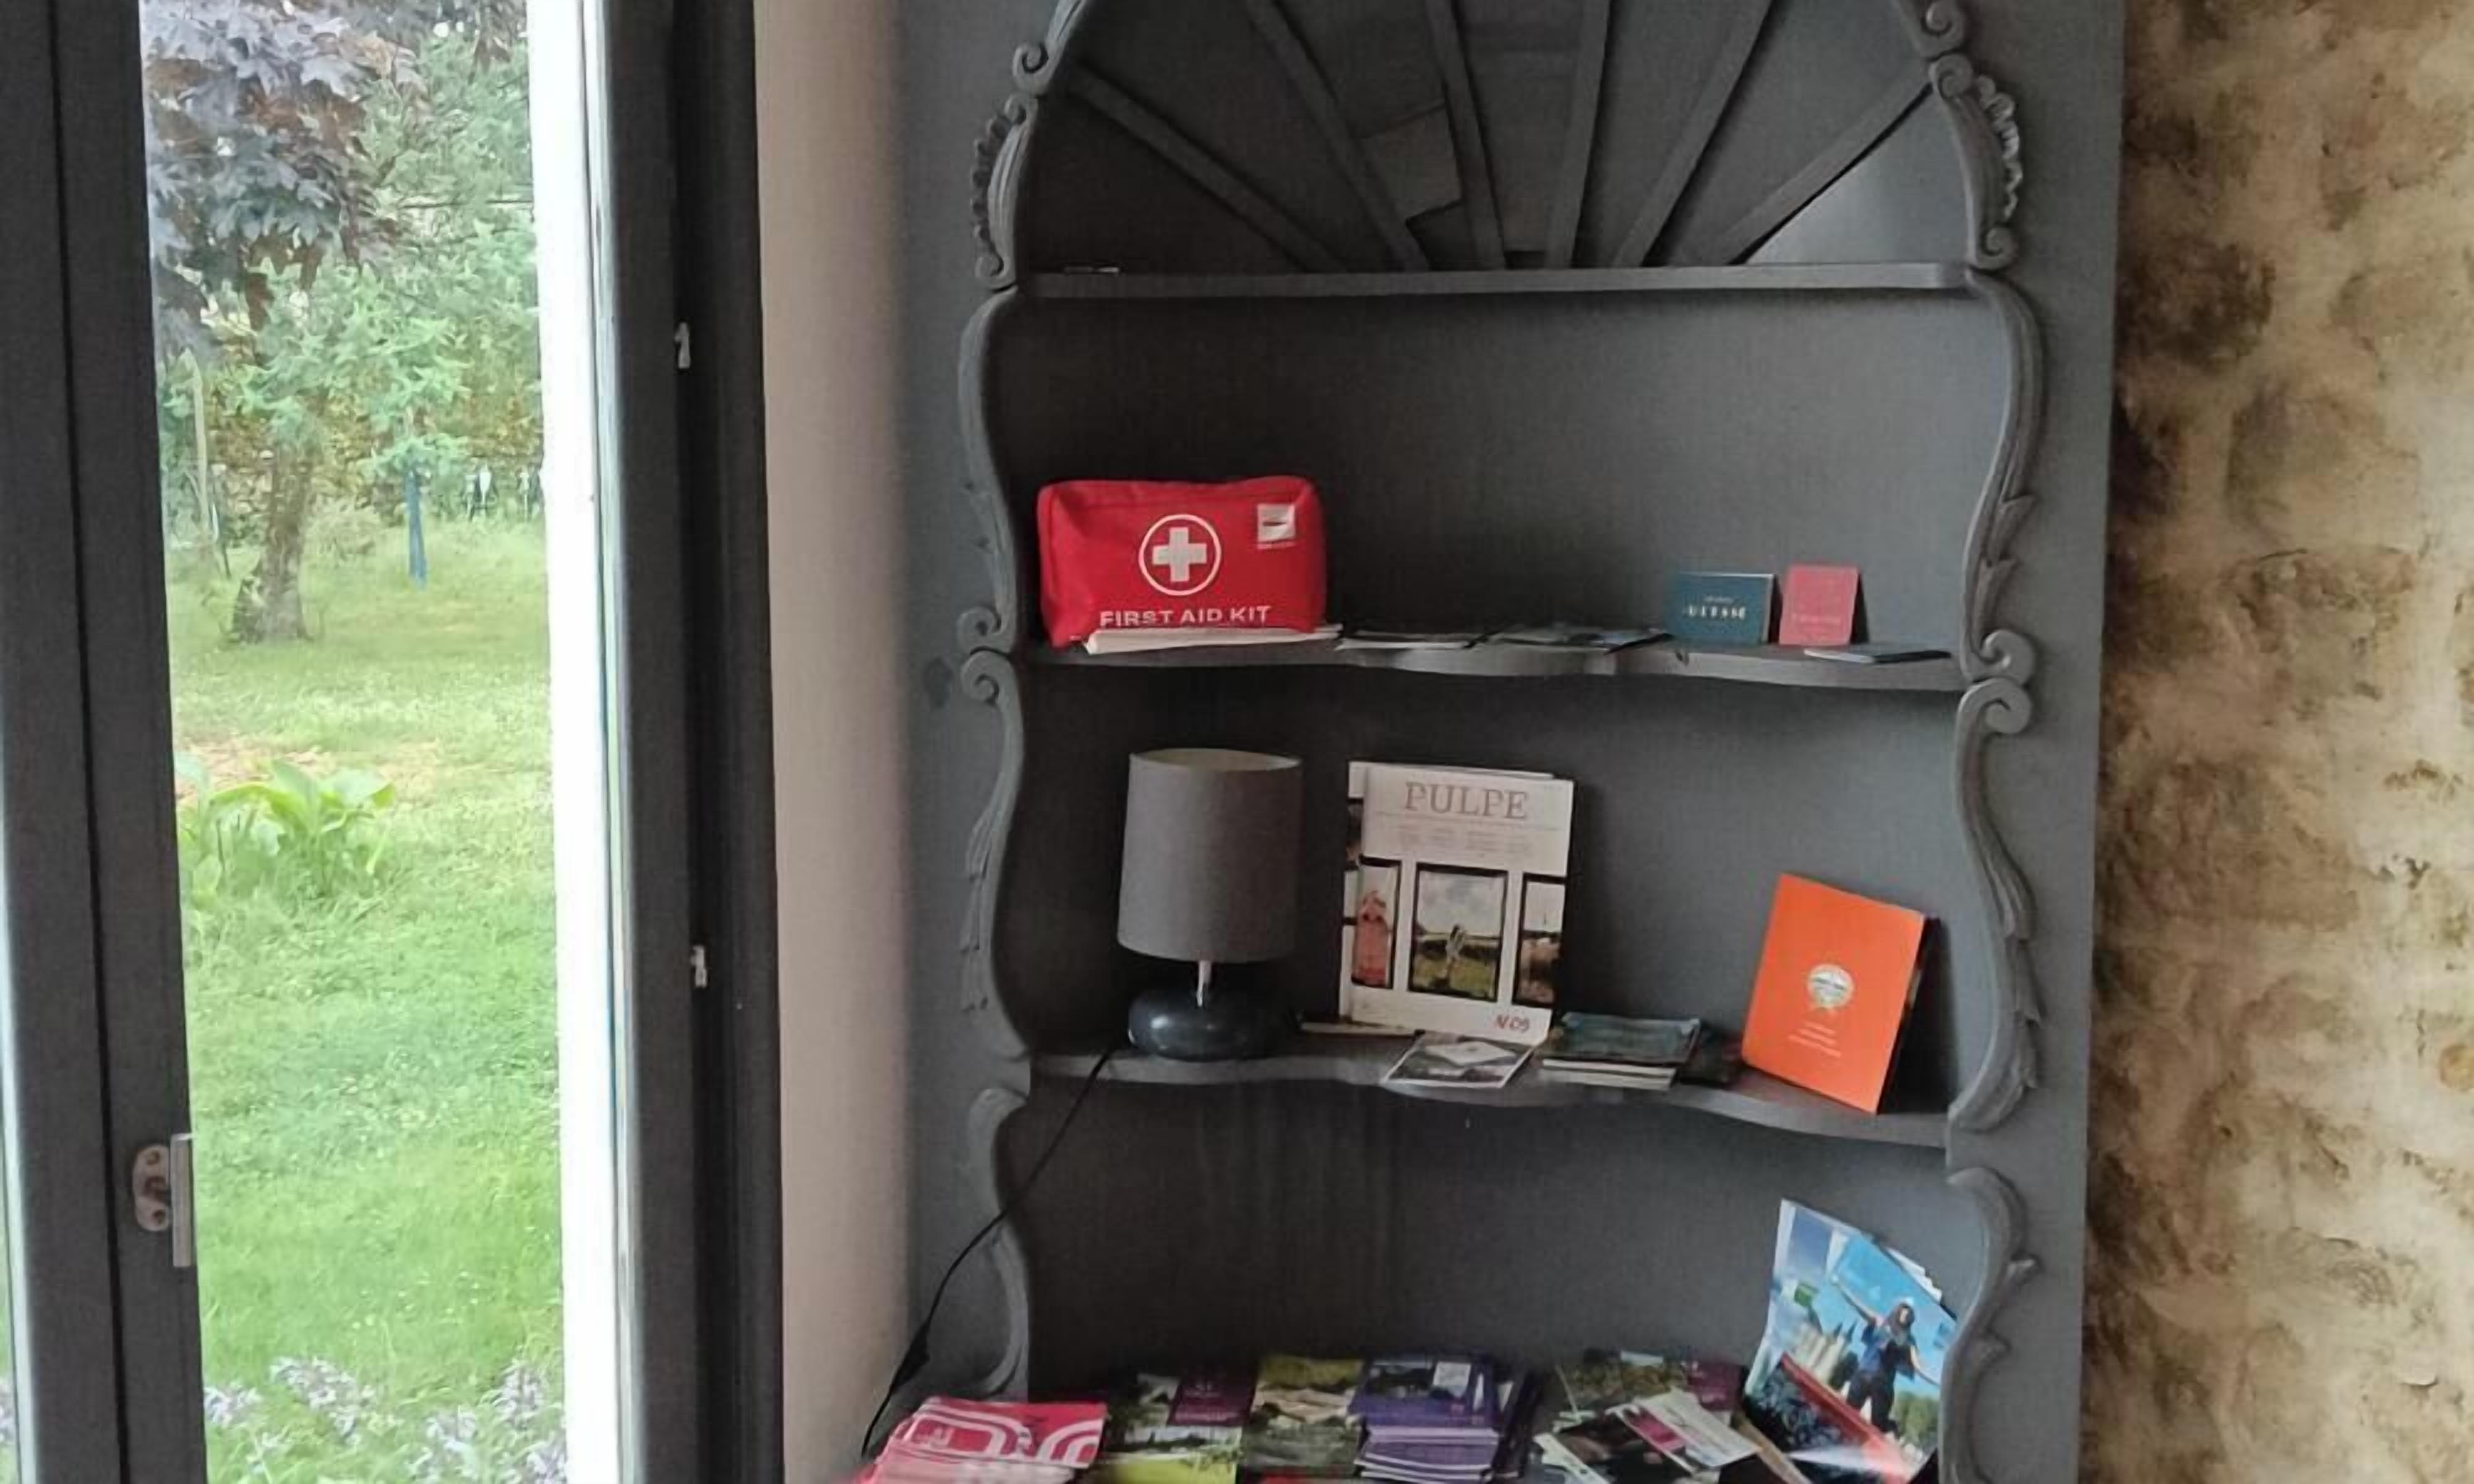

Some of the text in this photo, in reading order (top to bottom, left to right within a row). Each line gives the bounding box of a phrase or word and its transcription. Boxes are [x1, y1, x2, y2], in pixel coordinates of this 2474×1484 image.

[1100, 605, 1271, 627] FIRST AID KIT
[1405, 782, 1529, 819] PULPE
